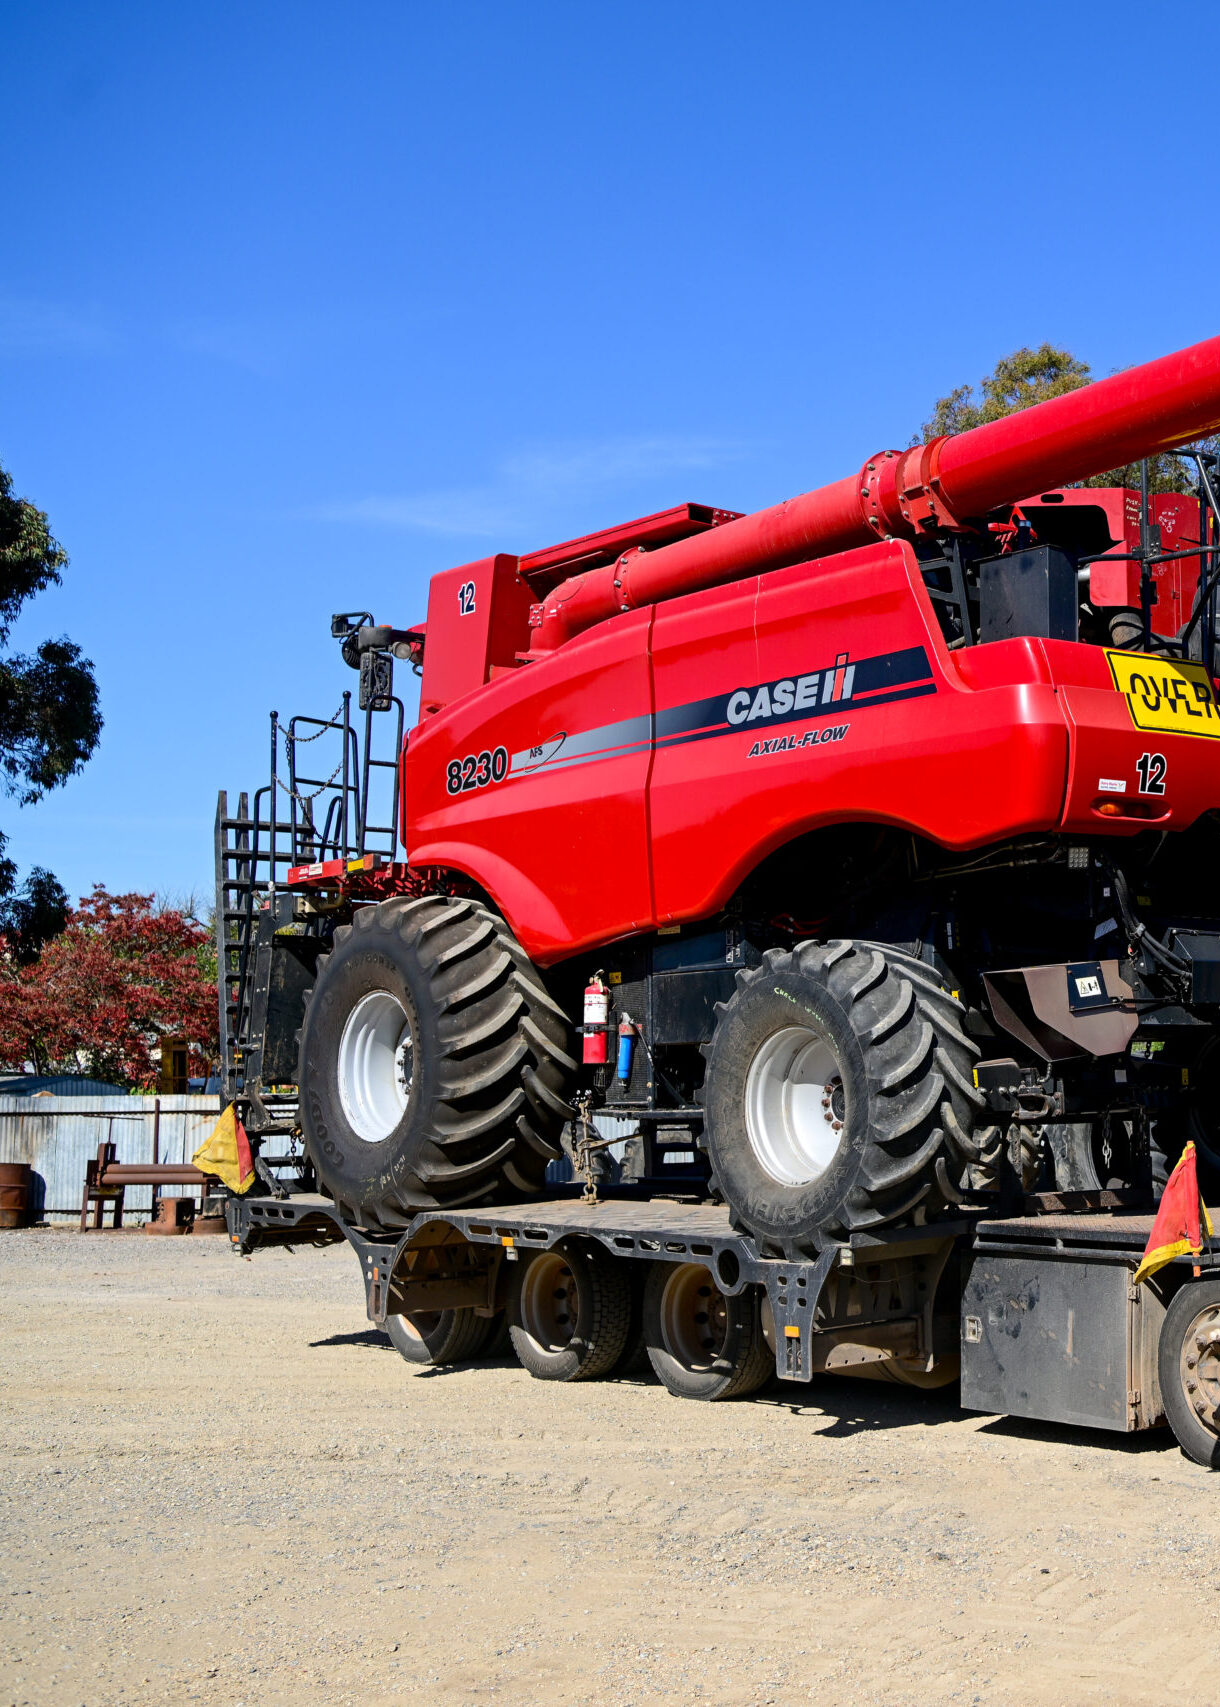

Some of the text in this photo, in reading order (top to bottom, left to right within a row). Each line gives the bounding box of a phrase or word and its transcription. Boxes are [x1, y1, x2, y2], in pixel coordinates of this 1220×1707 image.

[458, 581, 476, 616] 12
[726, 673, 820, 725] CASE
[746, 723, 851, 759] AXIAL-FLOW
[446, 745, 544, 796] 8230 AFS
[1136, 752, 1168, 796] 12
